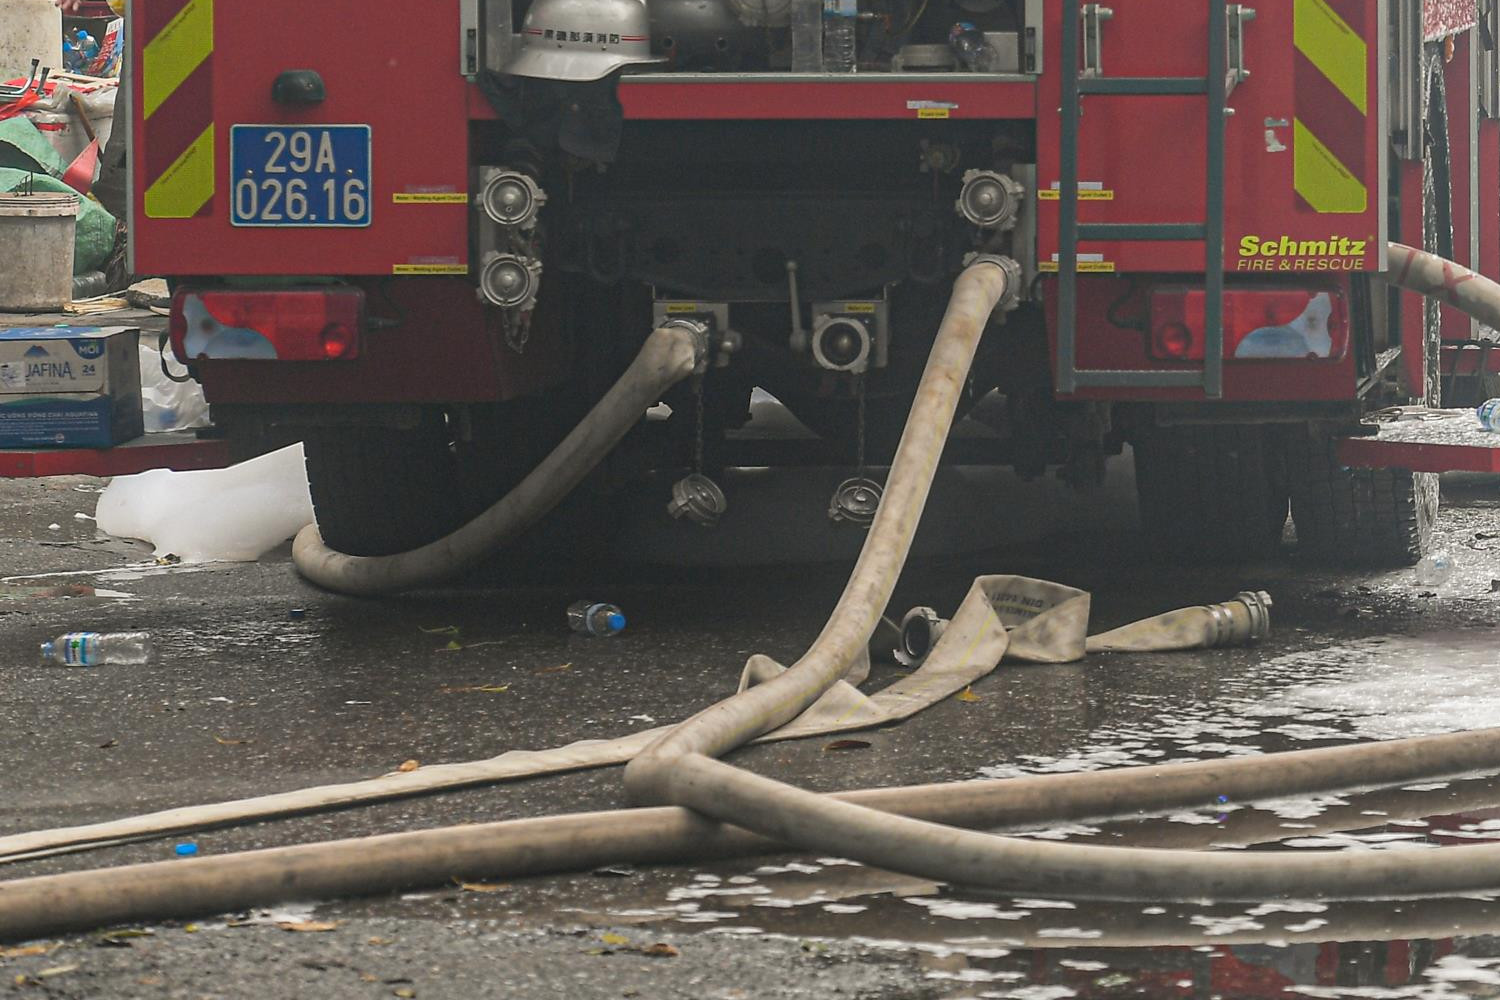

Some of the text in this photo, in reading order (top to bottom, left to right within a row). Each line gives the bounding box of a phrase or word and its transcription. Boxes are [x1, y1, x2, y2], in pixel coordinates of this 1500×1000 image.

[264, 131, 335, 173] 29A
[236, 178, 365, 220] 026.16
[1239, 235, 1367, 256] Schmitz
[1238, 258, 1365, 271] FIRE & RESCUE
